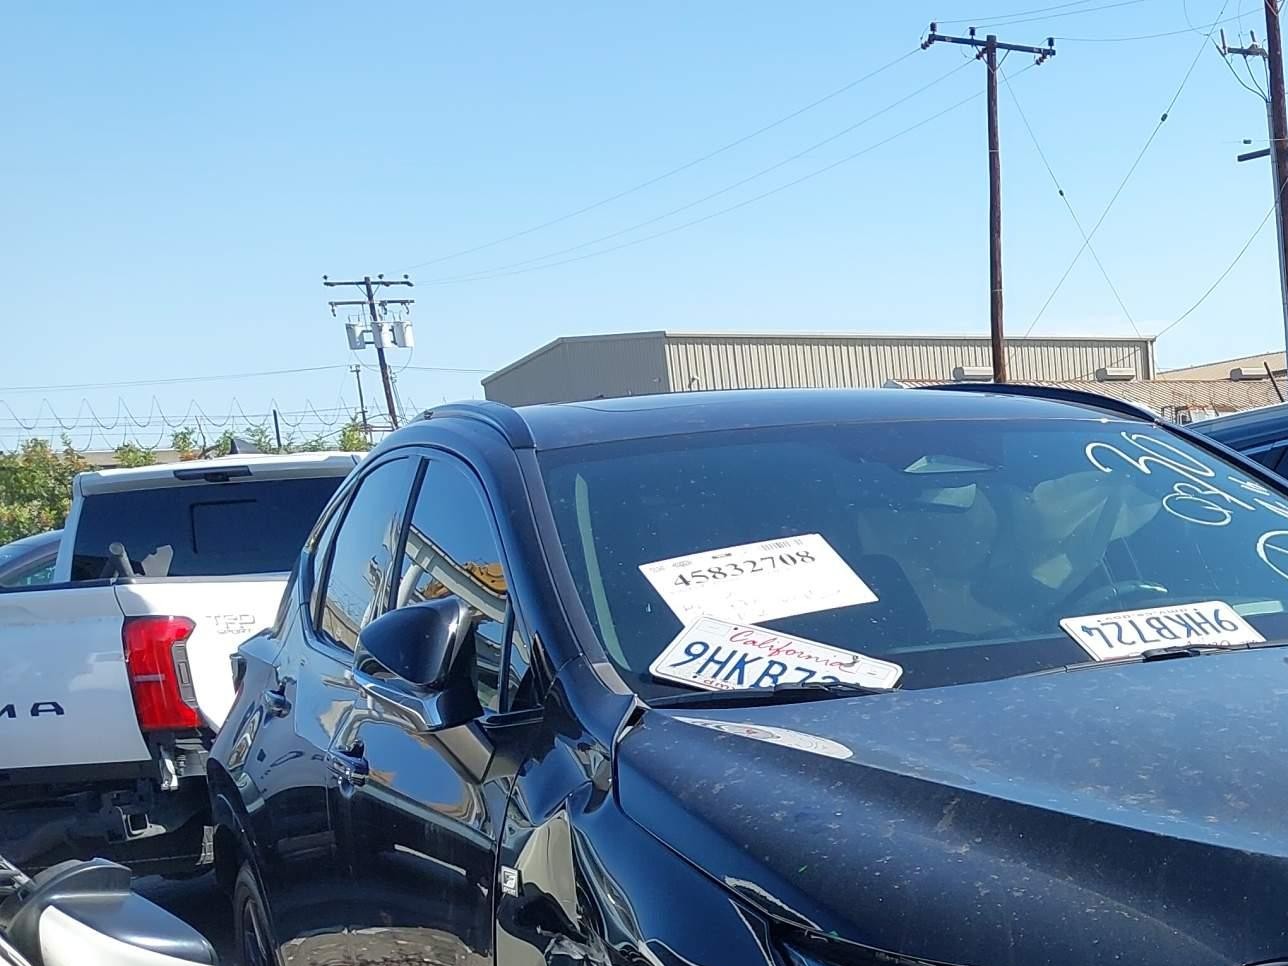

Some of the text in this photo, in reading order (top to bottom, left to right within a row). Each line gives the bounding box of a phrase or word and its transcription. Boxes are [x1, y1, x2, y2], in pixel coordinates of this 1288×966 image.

[673, 550, 816, 588] 45832708
[1080, 608, 1239, 649] 9HKB724
[670, 641, 841, 689] 9HKB7
[729, 629, 857, 674] California
